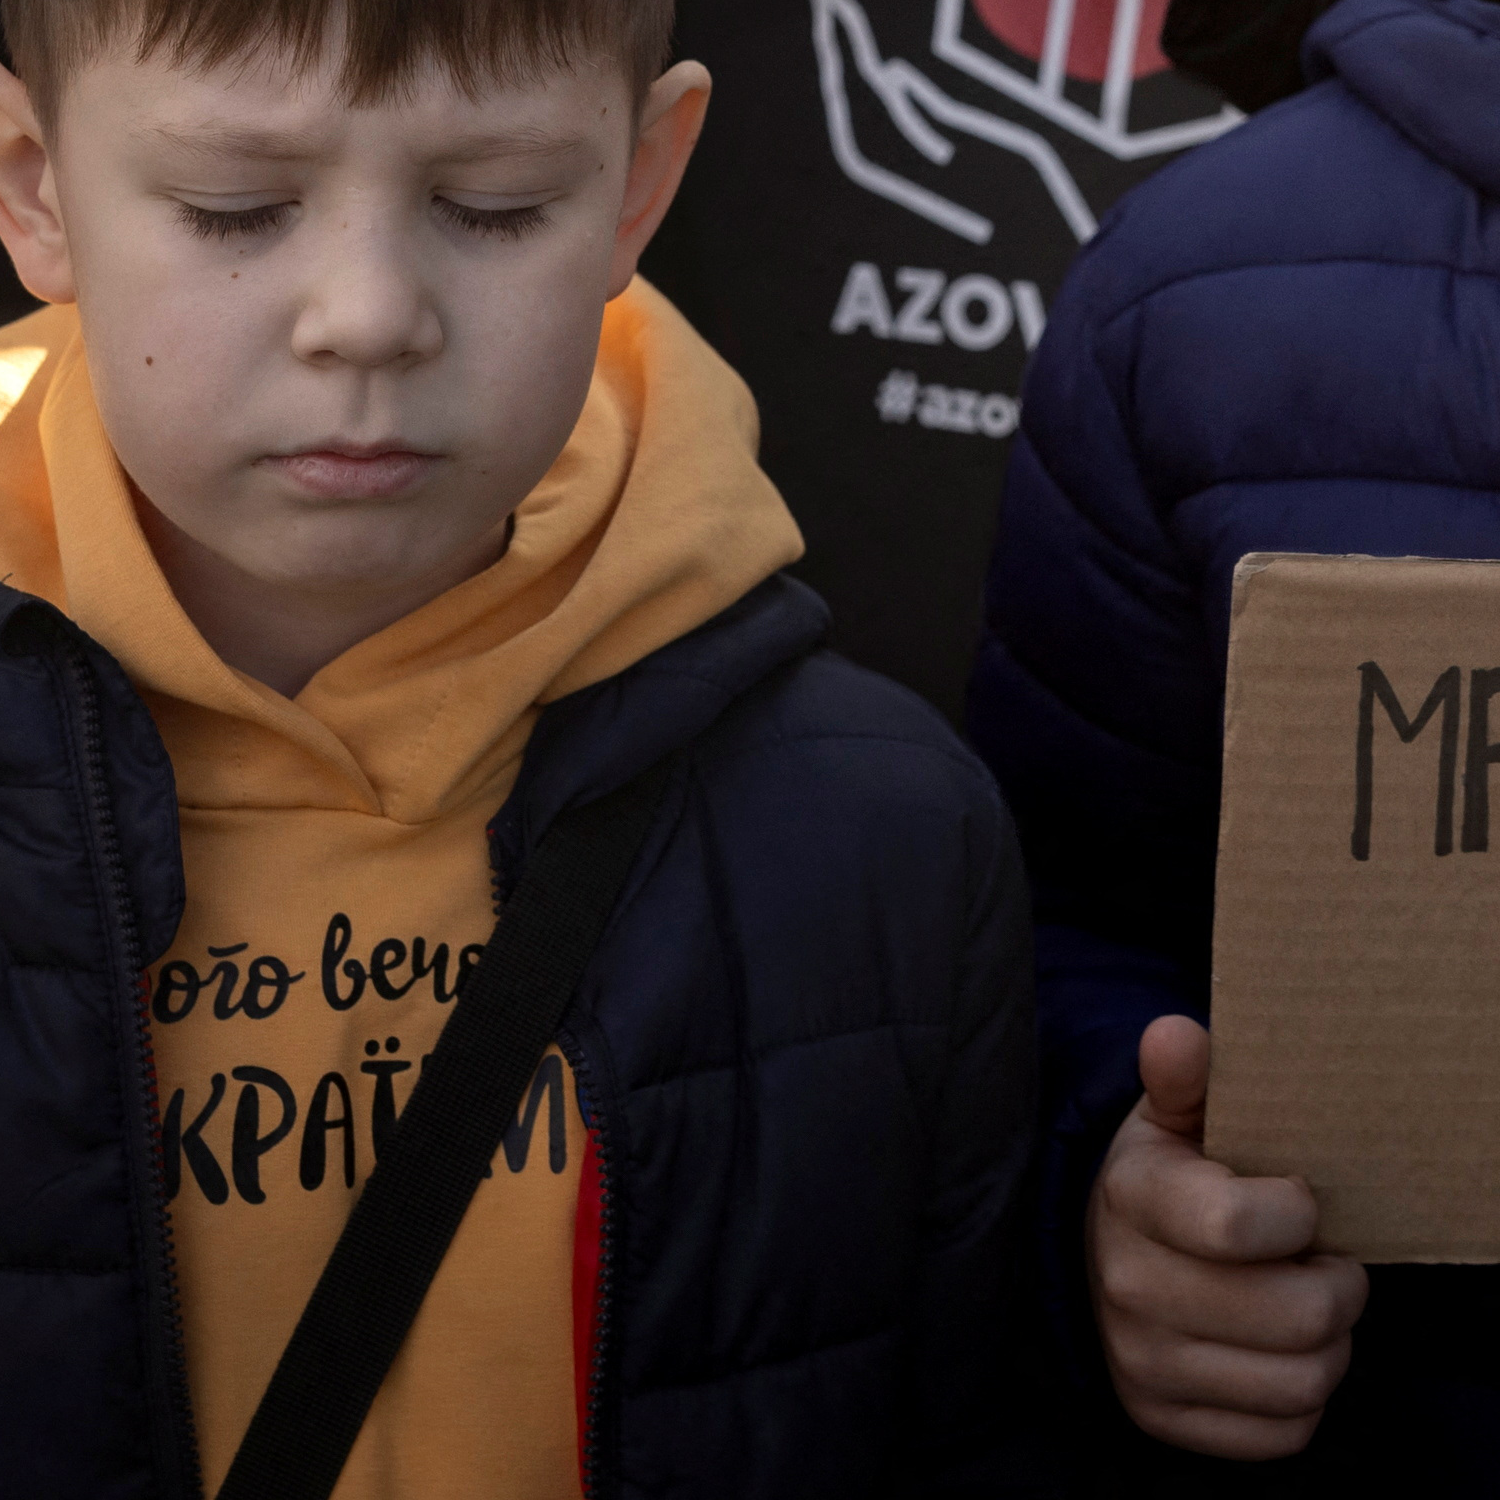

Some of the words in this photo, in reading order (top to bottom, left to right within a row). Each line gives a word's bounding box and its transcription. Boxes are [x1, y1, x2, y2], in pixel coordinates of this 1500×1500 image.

[874, 368, 1023, 439] #azo
[148, 942, 306, 1025] ого
[160, 1036, 568, 1206] КРАЇИ
